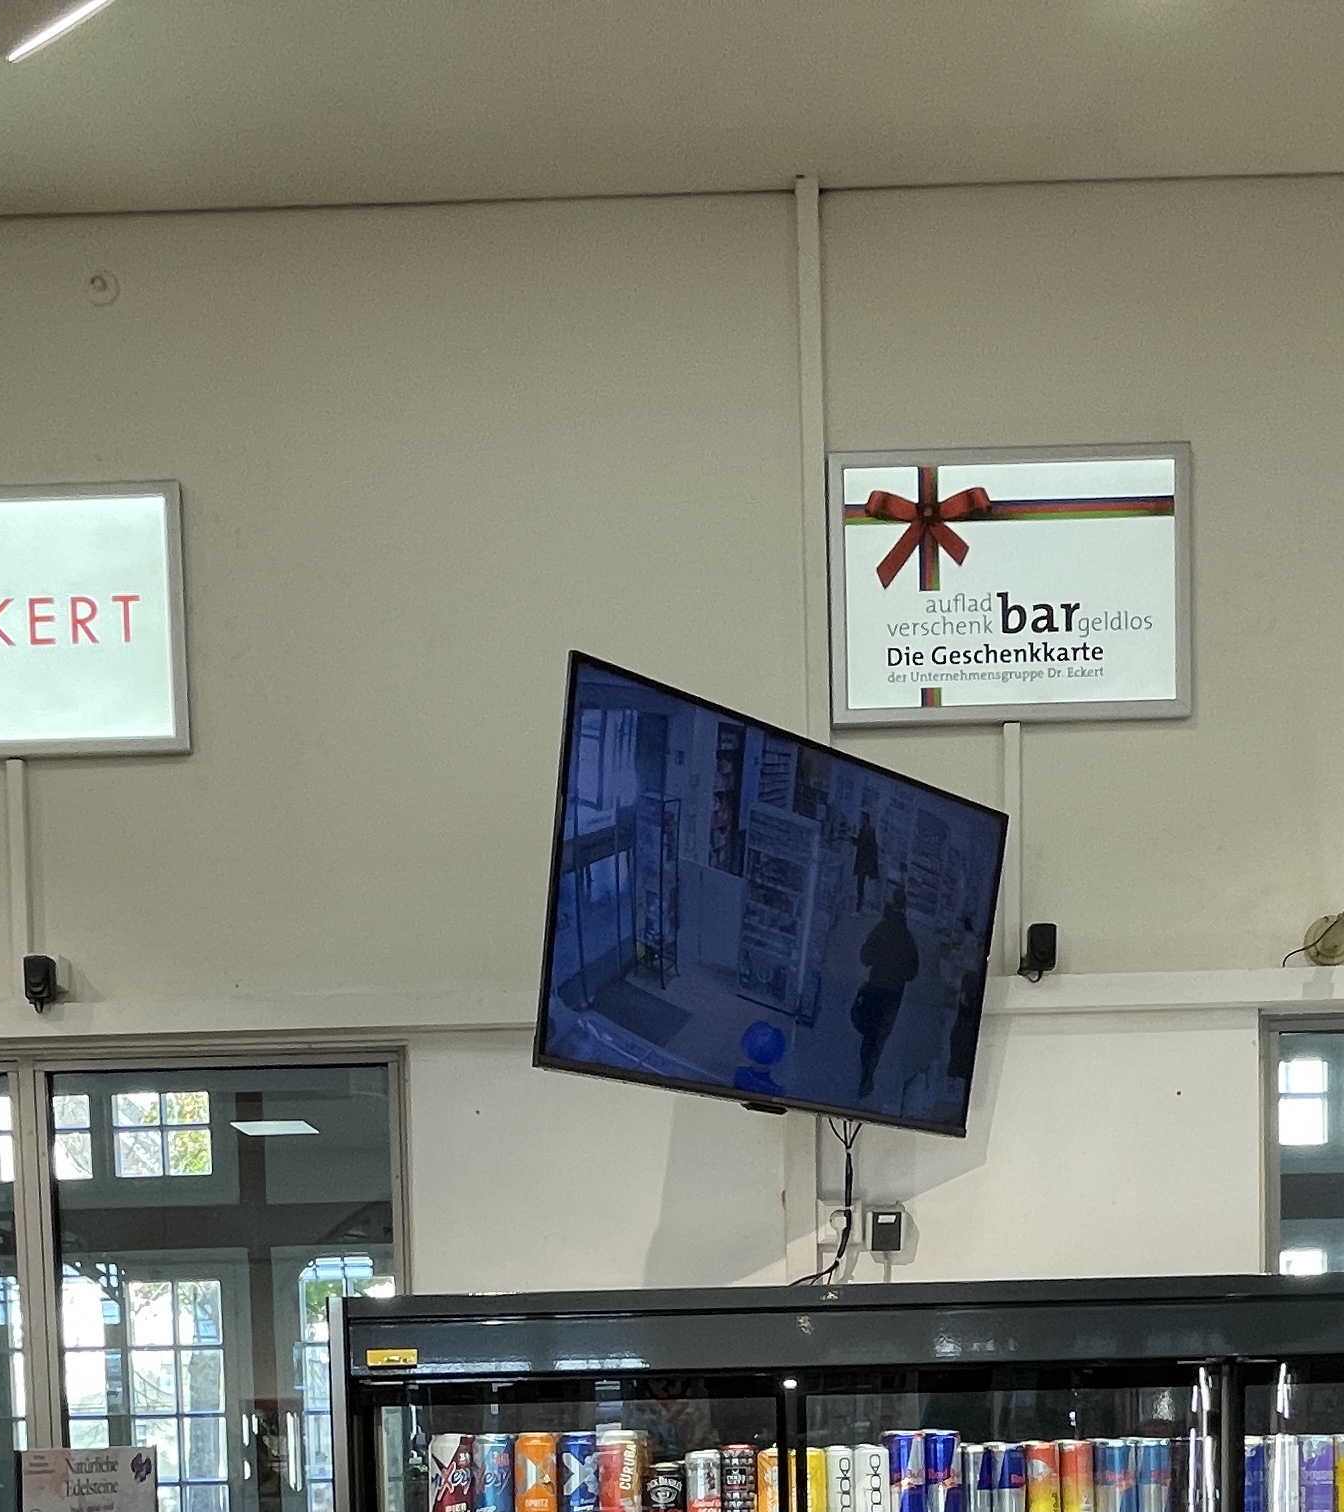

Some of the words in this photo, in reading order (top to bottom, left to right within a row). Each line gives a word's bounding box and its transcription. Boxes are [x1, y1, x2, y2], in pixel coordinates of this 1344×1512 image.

[887, 615, 993, 637] verschenk
[1078, 611, 1153, 638] geldlos
[925, 593, 992, 614] auflad
[997, 592, 1080, 634] bar
[887, 647, 924, 666] Die
[932, 642, 1103, 665] Geschenkkarte
[888, 673, 907, 683] der
[910, 667, 1044, 684] Unternehmensgruppe
[1067, 666, 1104, 678] Eckert
[619, 1443, 637, 1491] CURUBA
[66, 1479, 118, 1497] Edelsteine
